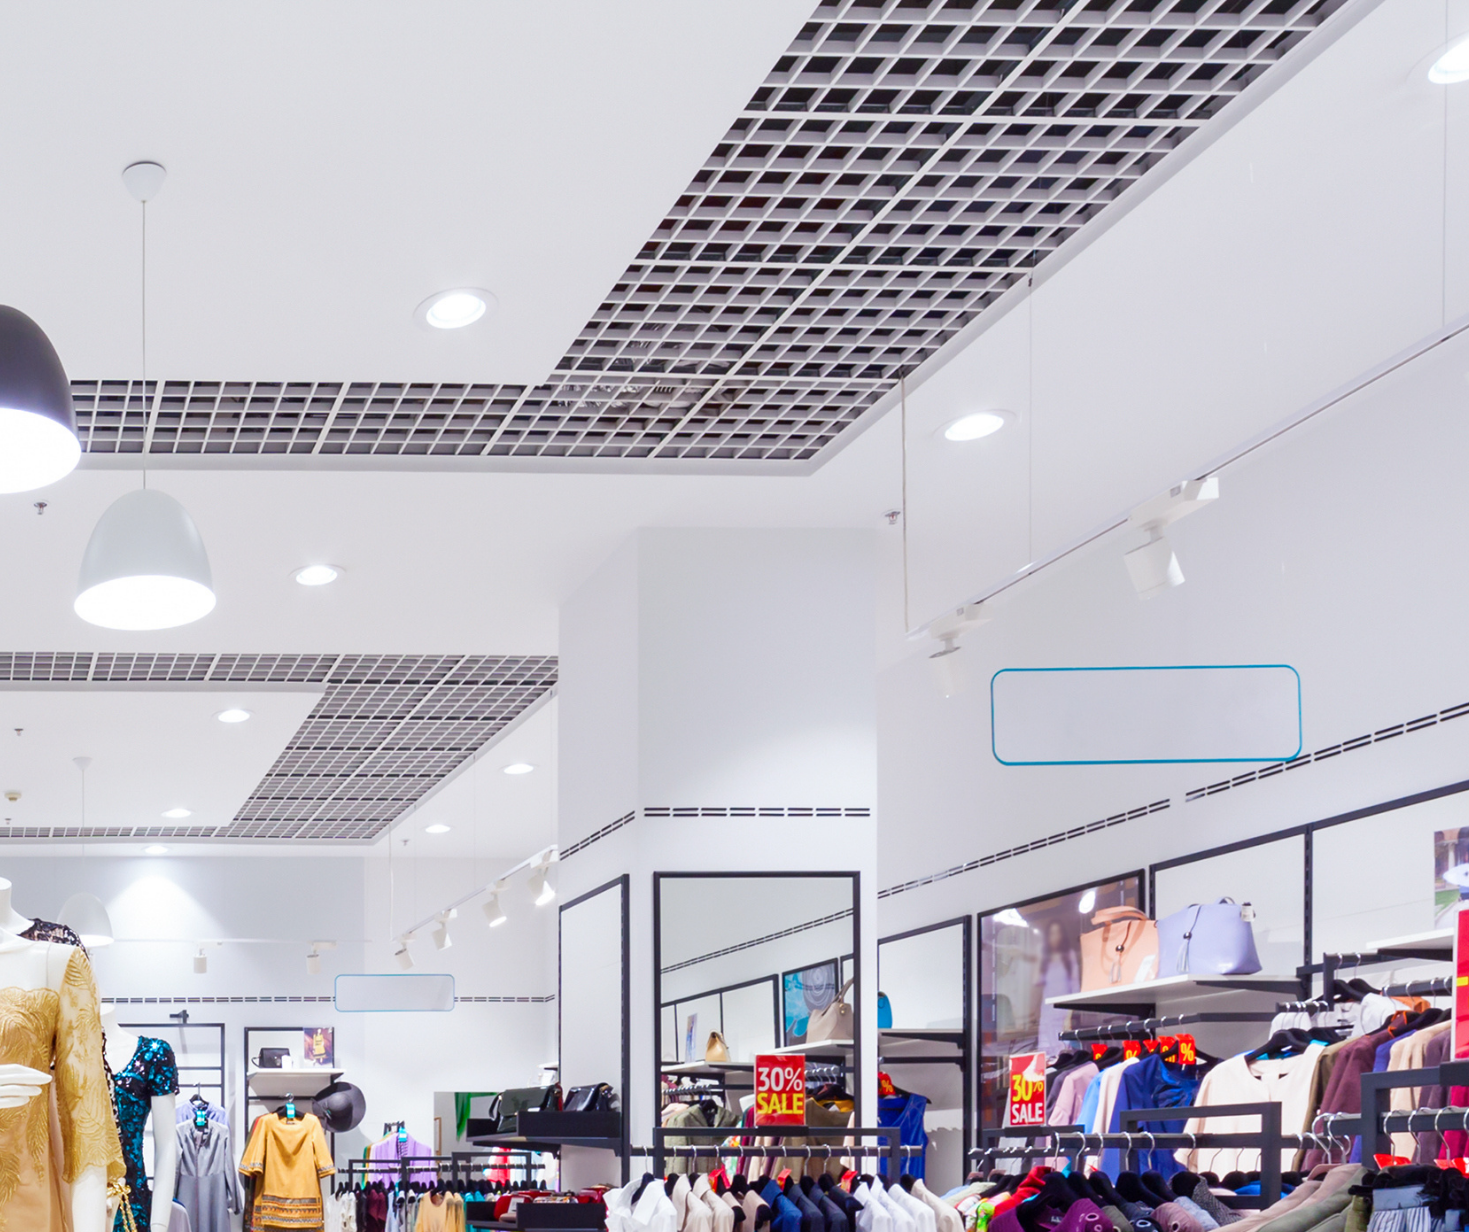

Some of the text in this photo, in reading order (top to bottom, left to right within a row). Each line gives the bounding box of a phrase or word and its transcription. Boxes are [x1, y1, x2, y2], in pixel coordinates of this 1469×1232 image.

[1180, 1042, 1194, 1062] %
[758, 1067, 803, 1092] 30%
[1012, 1074, 1044, 1102] 30%
[757, 1092, 804, 1115] SALE
[1012, 1103, 1043, 1124] SALE
